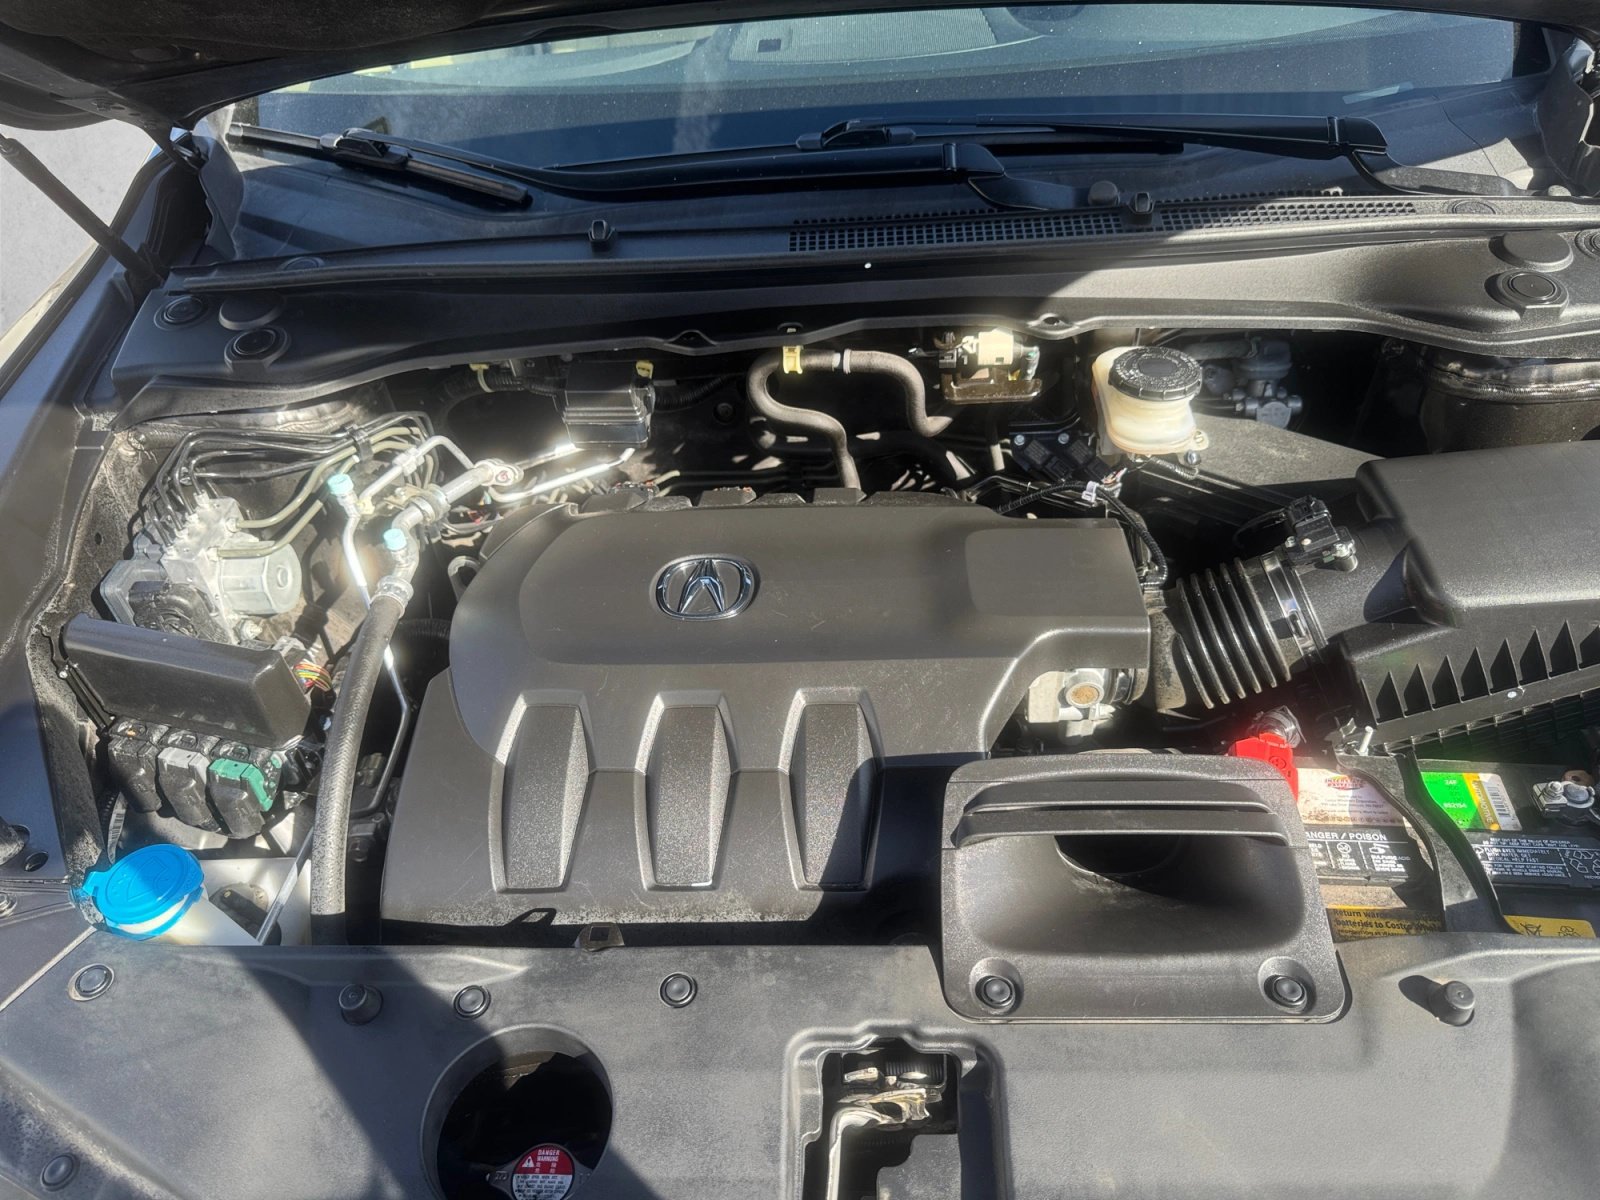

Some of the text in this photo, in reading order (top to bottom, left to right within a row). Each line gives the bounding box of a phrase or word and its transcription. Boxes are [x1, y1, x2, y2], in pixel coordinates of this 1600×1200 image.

[1305, 831, 1339, 840] ANGER
[1348, 832, 1387, 841] POISON
[1333, 909, 1361, 918] Return
[1335, 918, 1373, 928] batteries
